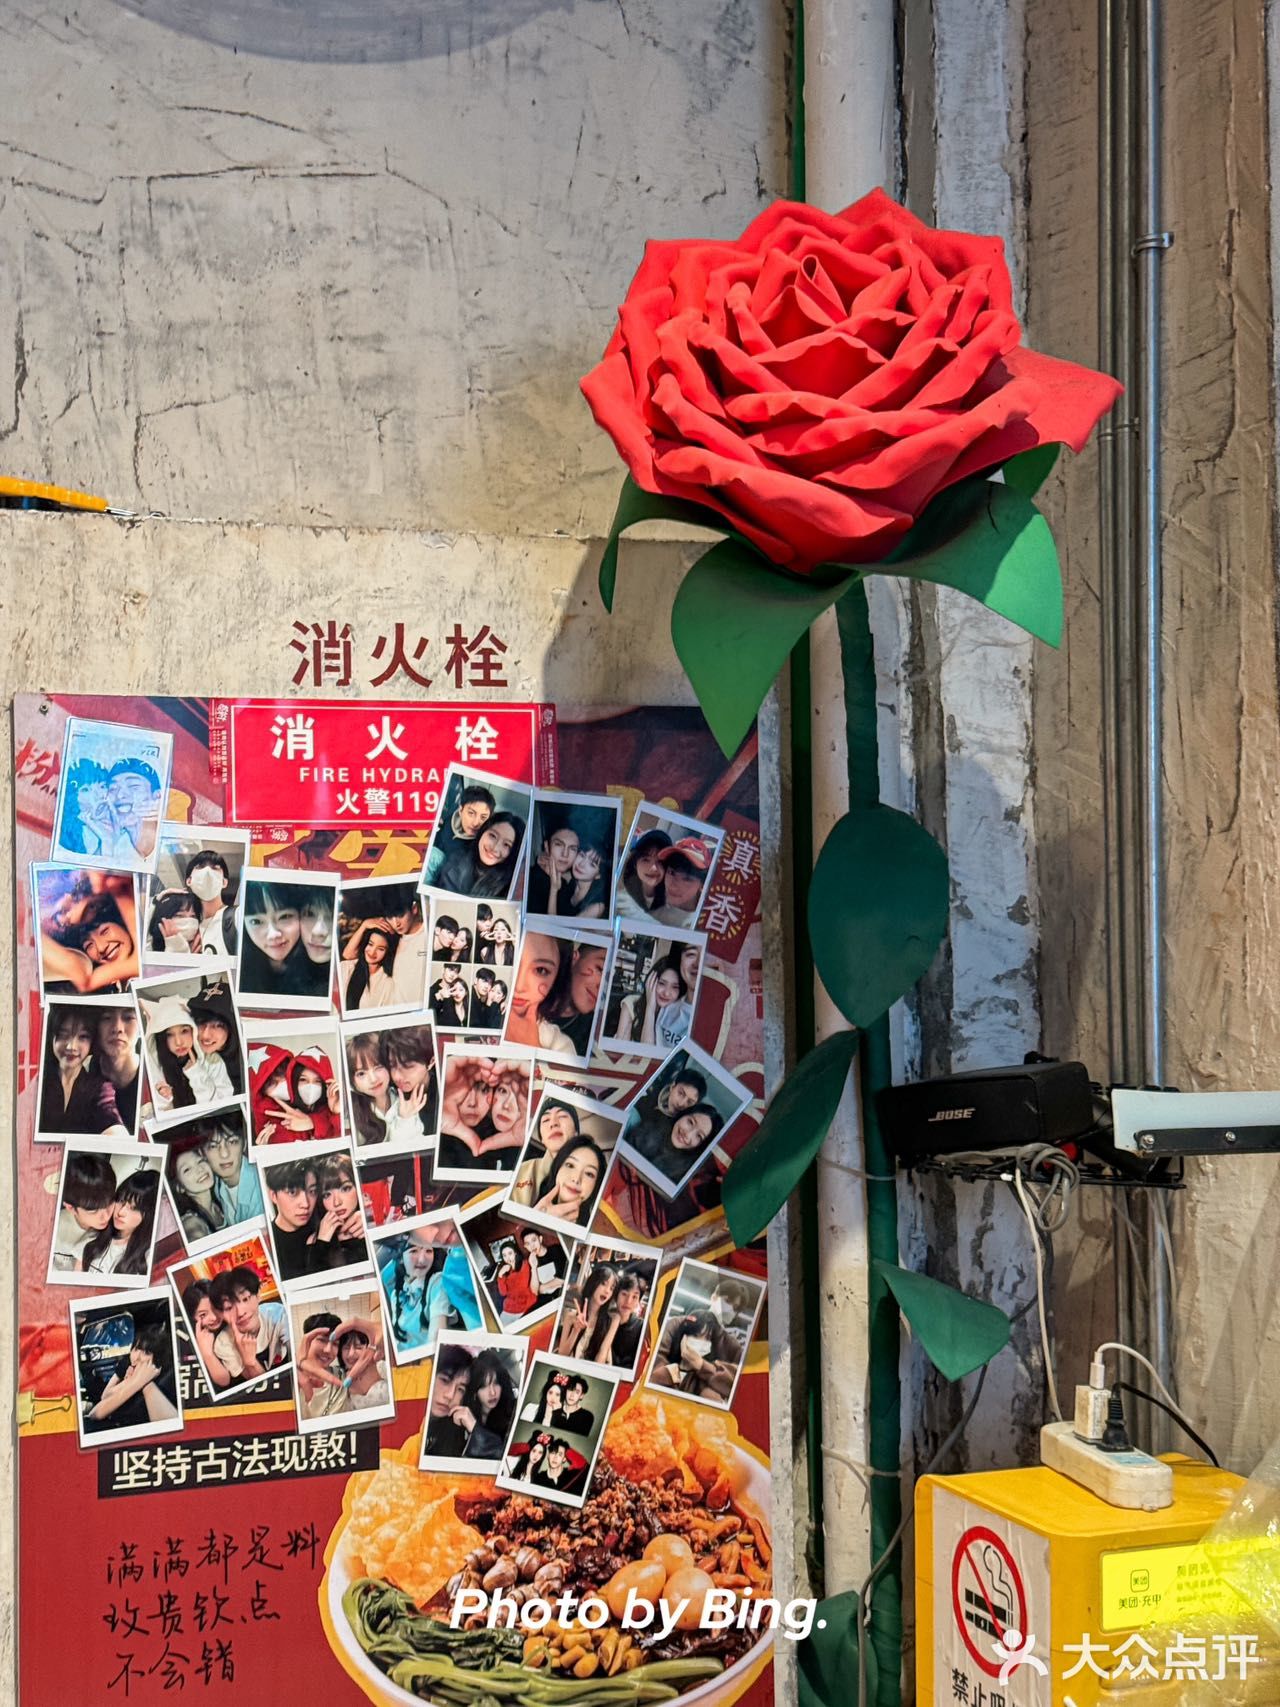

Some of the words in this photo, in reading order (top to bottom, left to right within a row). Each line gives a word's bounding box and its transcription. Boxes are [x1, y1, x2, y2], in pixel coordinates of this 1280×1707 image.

[289, 620, 508, 689] 消火栓
[270, 714, 500, 762] 消火栓
[299, 767, 350, 783] FIRE
[362, 767, 449, 784] HYDRA
[335, 788, 438, 816] 火警119
[703, 838, 759, 935] 真香
[928, 1108, 976, 1122] BOSE
[112, 1431, 358, 1490] 坚持古法现熬!
[107, 1640, 235, 1697] 不会错
